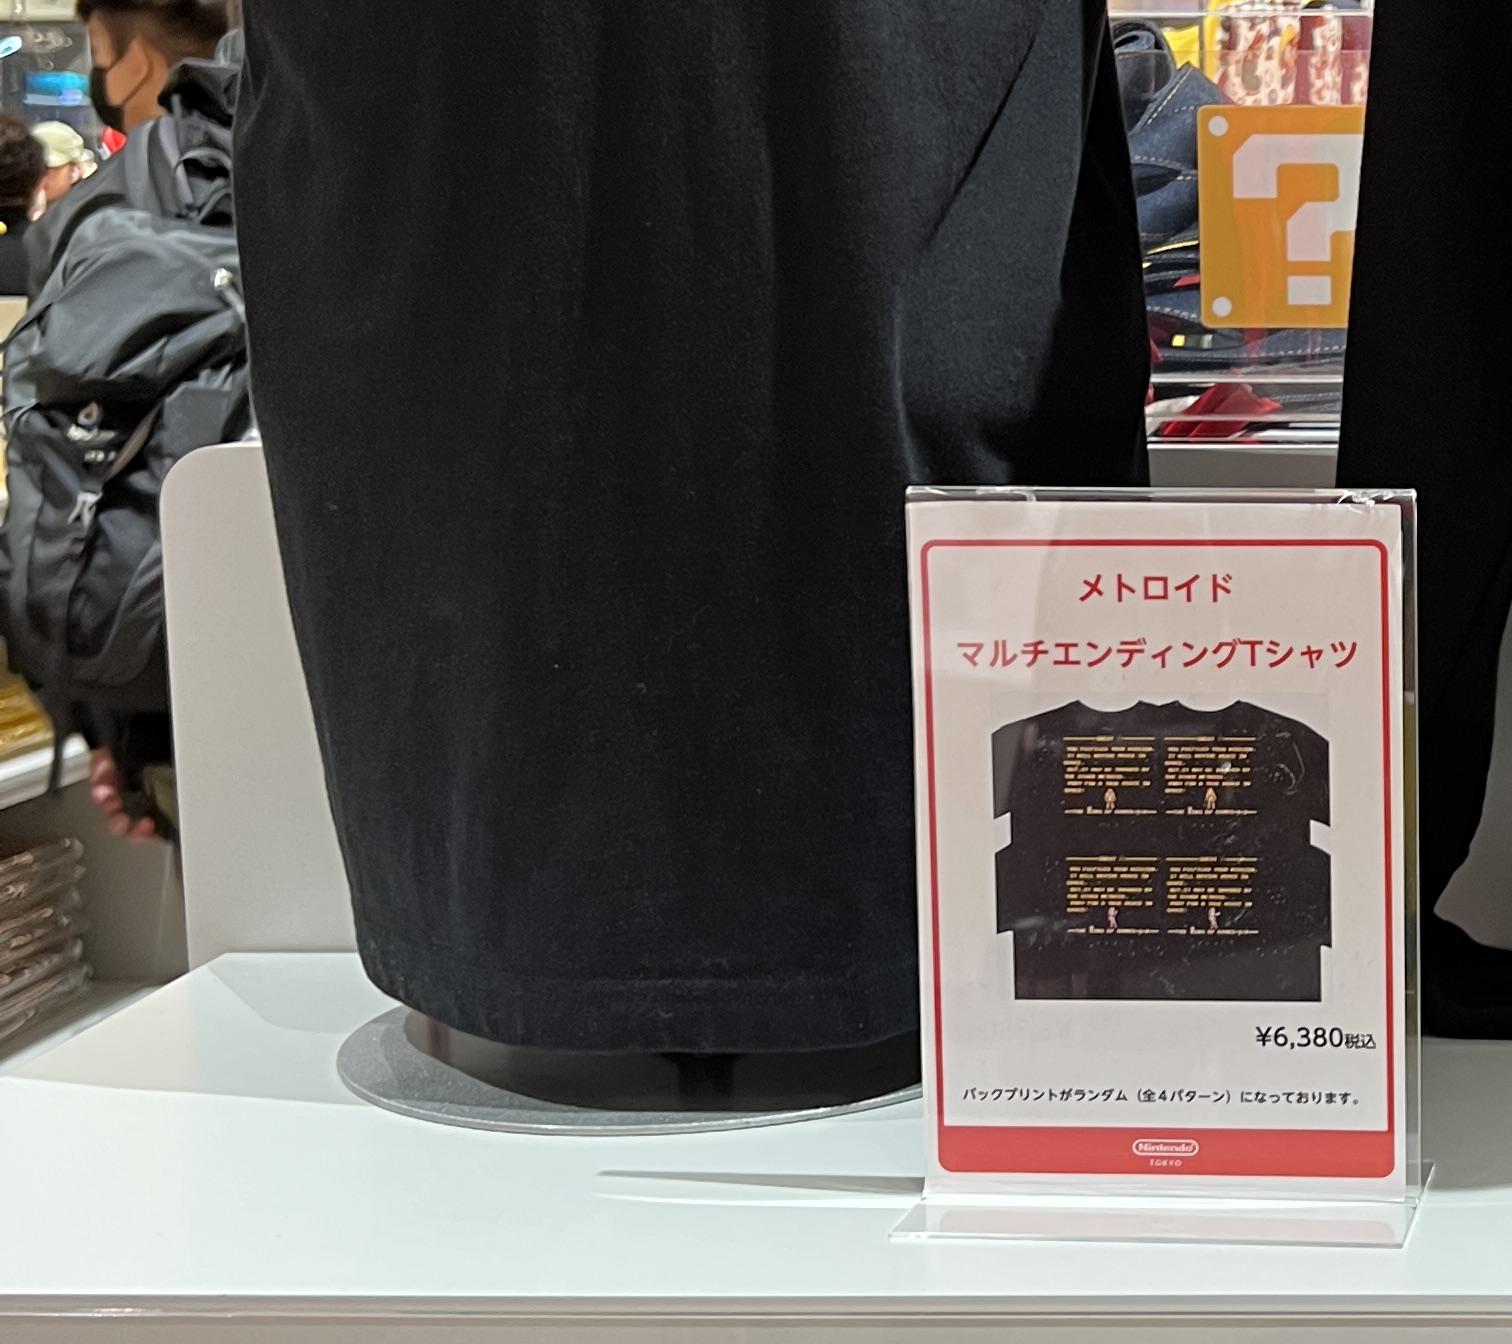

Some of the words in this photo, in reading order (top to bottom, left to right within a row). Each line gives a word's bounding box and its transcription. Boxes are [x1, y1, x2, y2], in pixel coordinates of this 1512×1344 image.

[1078, 573, 1233, 603] メトロイド
[956, 636, 1358, 669] マルチエンディングTシャツ
[1138, 1142, 1194, 1152] Nintendo
